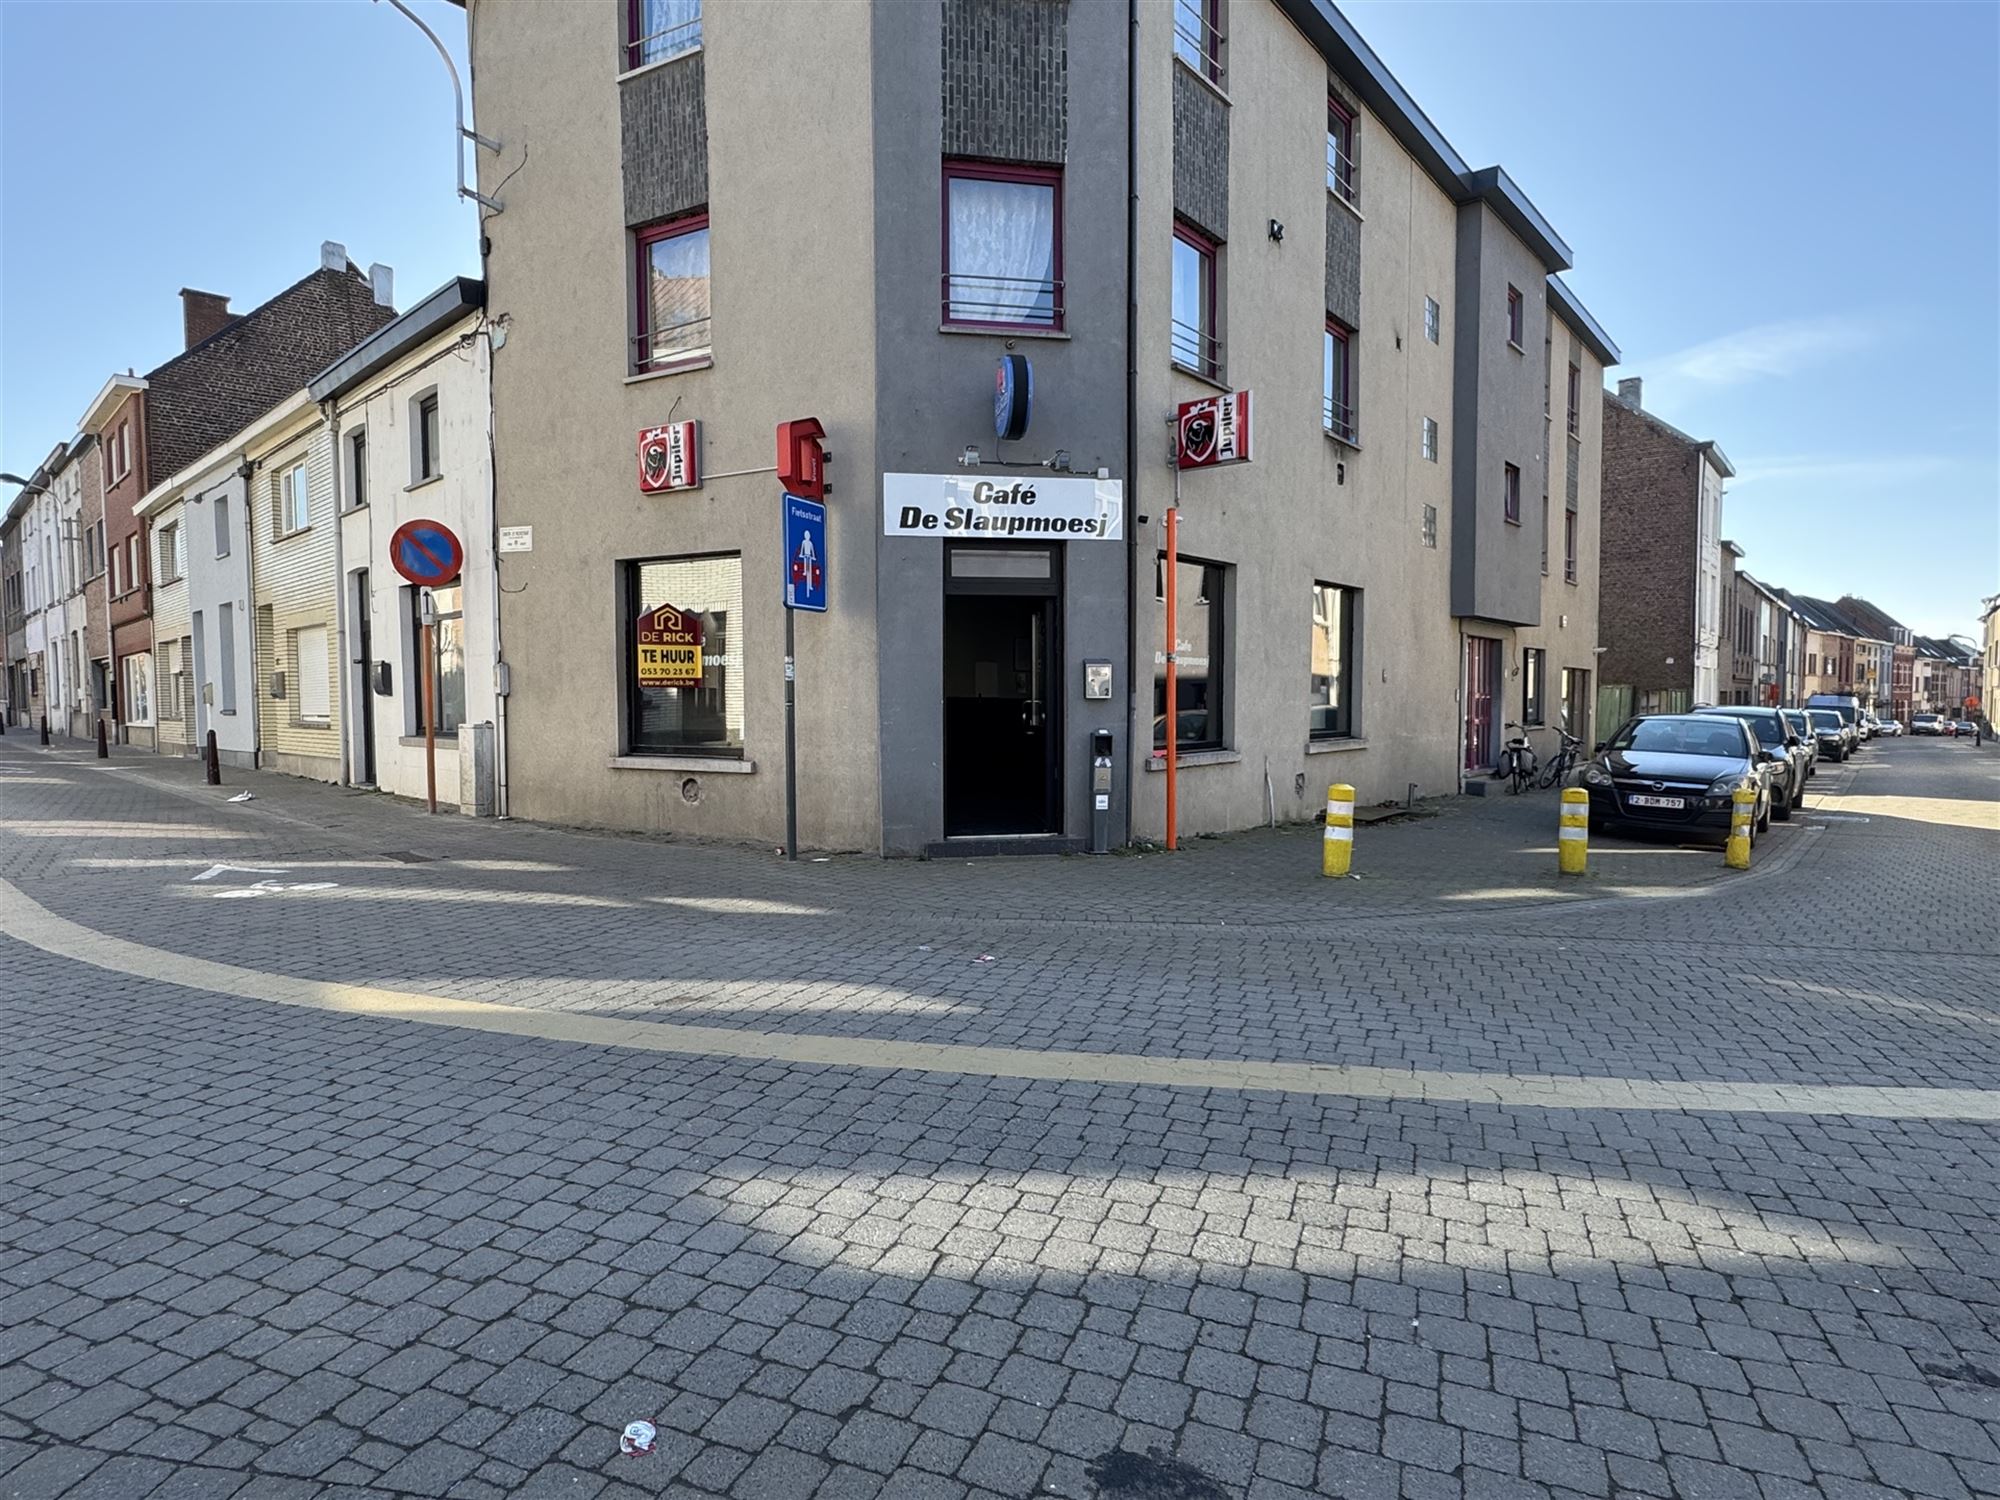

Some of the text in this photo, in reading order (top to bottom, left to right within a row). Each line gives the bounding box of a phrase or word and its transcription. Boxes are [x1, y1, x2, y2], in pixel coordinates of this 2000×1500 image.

[1220, 397, 1235, 457] Jupiler
[671, 424, 684, 483] Jupiler
[973, 481, 1037, 505] Café
[791, 506, 823, 523] Fietsstraat
[899, 506, 1108, 537] De Slaupmoesj
[641, 631, 660, 642] DE
[663, 631, 694, 643] RICK
[641, 649, 695, 664] TE HUUR
[641, 667, 696, 676] 053 70 23 67
[641, 679, 696, 687] www.derick.be
